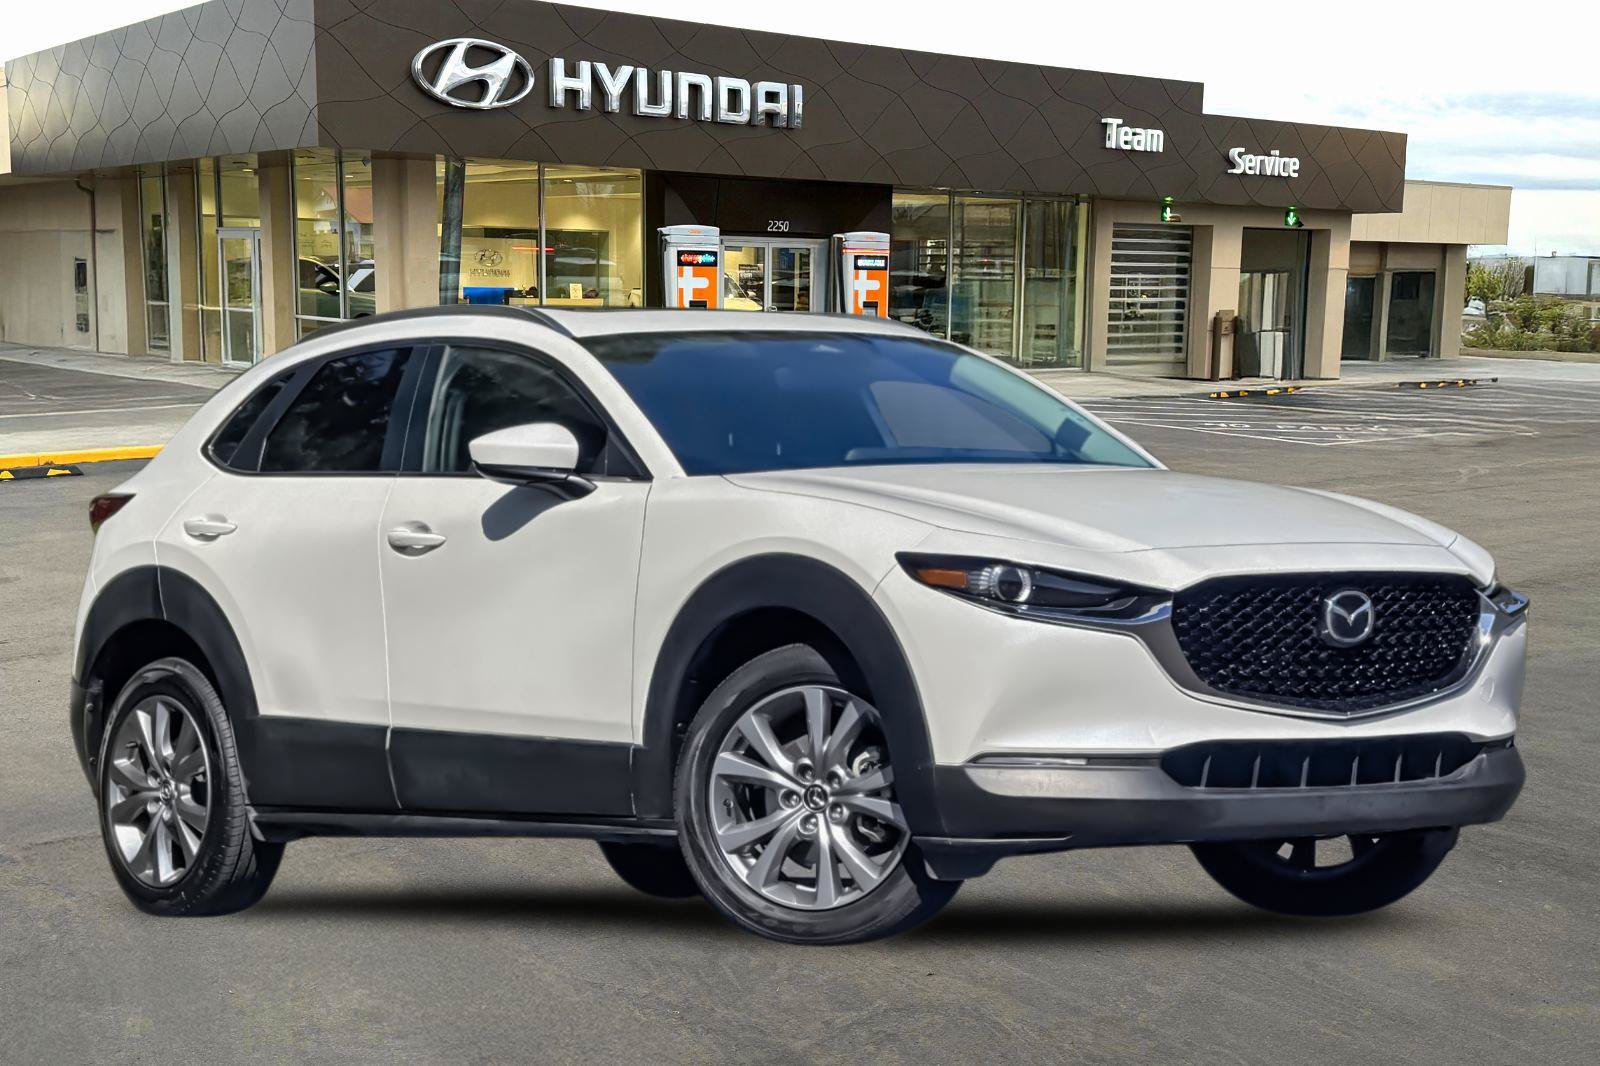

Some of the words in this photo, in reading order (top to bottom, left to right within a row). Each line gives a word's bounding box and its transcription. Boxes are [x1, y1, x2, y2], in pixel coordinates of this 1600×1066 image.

[549, 57, 803, 129] HYUNDAI
[1101, 117, 1164, 153] Team
[1227, 147, 1300, 178] Service
[767, 220, 790, 232] 2250
